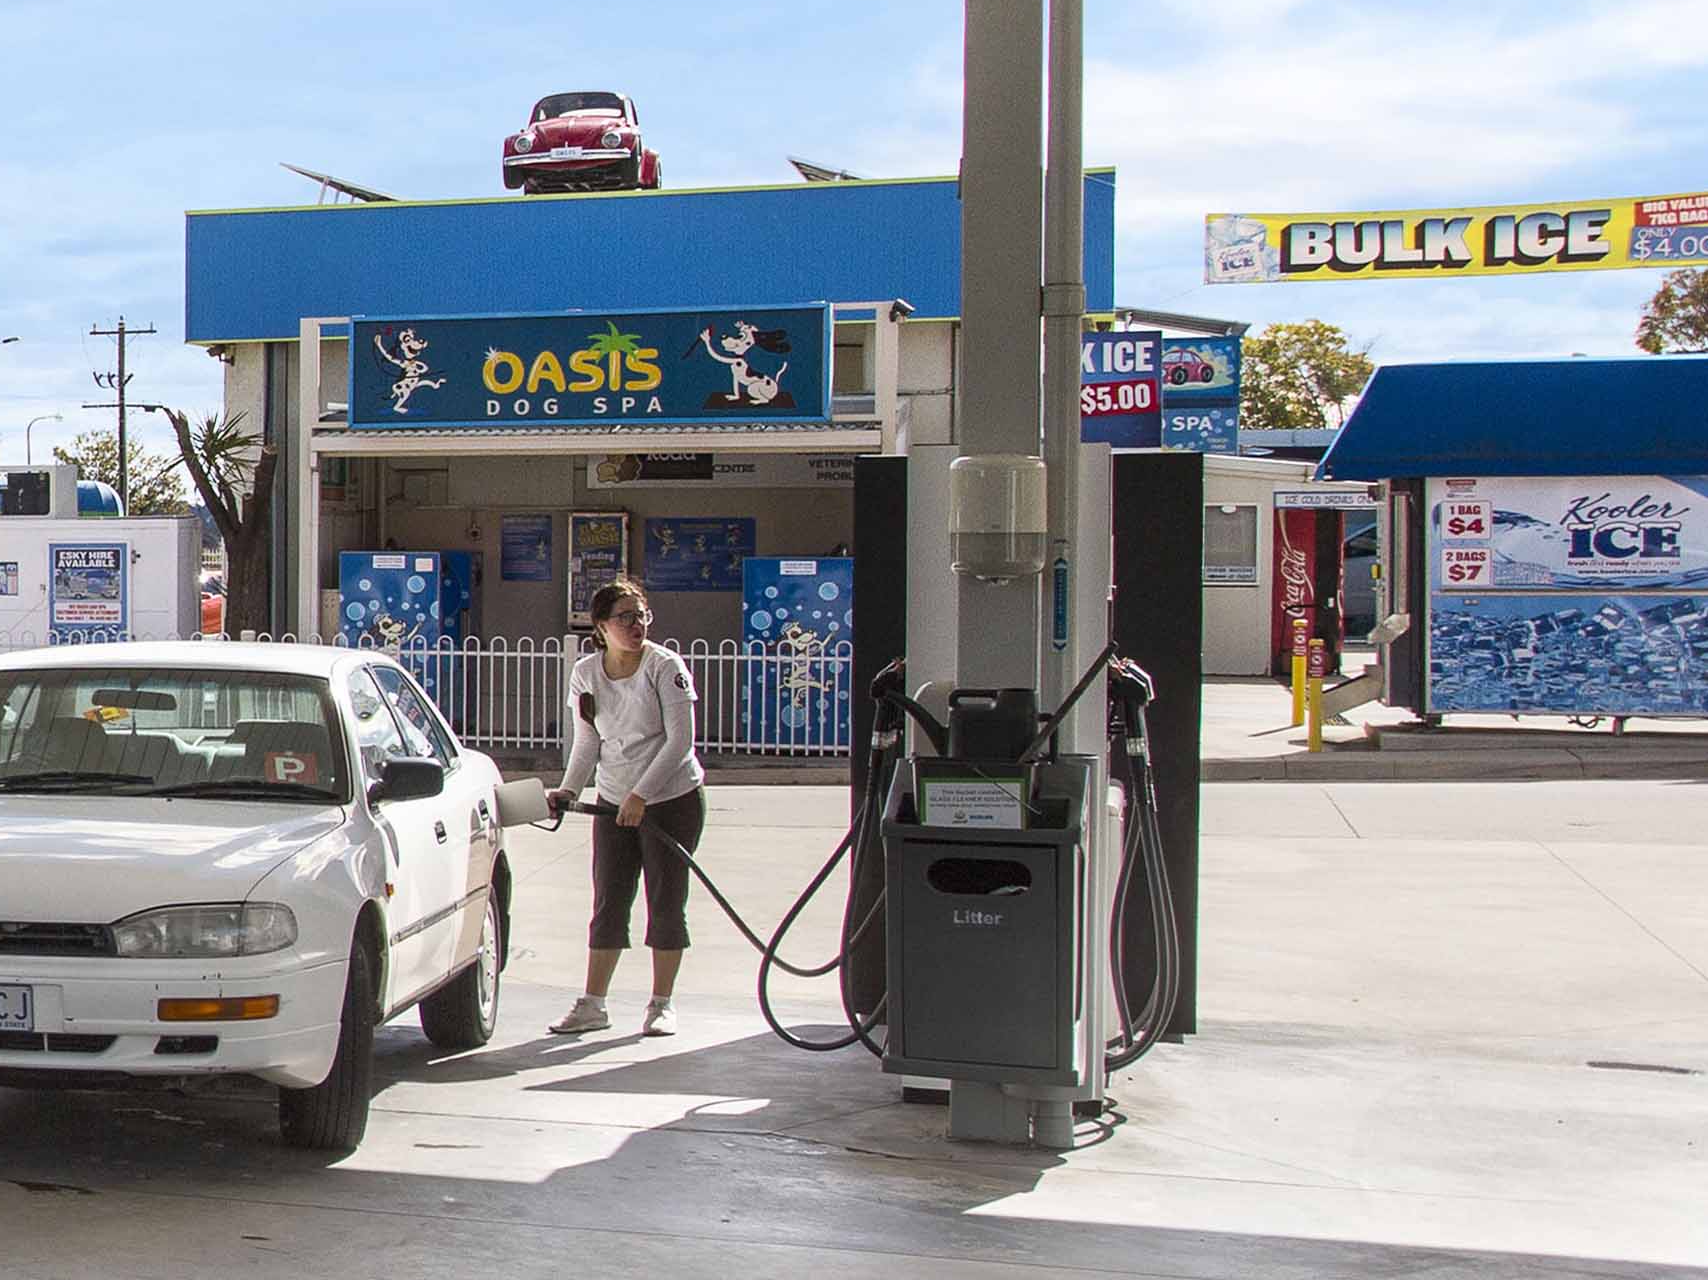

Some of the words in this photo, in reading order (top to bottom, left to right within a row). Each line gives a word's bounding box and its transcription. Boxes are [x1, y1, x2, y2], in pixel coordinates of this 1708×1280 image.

[1643, 202, 1668, 213] BIG
[1649, 213, 1678, 226] 7KG
[1280, 216, 1474, 273] BULK
[1484, 208, 1612, 267] ICE
[1638, 226, 1676, 239] ONLY
[1102, 341, 1154, 373] ICE
[482, 347, 662, 395] OASIS
[486, 397, 559, 416] DOG
[592, 395, 663, 415] SPA
[1081, 383, 1151, 415] $5.00
[1172, 415, 1214, 432] SPA
[816, 471, 856, 480] PROBL
[1450, 505, 1455, 515] 1
[1458, 505, 1481, 515] BAG
[1559, 492, 1691, 525] Kooler
[1447, 516, 1485, 536] $4
[1567, 520, 1682, 559] ICE
[57, 559, 116, 568] AVAILABLE
[59, 551, 87, 560] ESKY
[88, 551, 115, 560] HIRE
[1445, 552, 1454, 562] 2
[1456, 551, 1487, 562] BAGS
[1447, 563, 1482, 582] $7
[274, 756, 306, 781] P
[952, 909, 1004, 926] Litter
